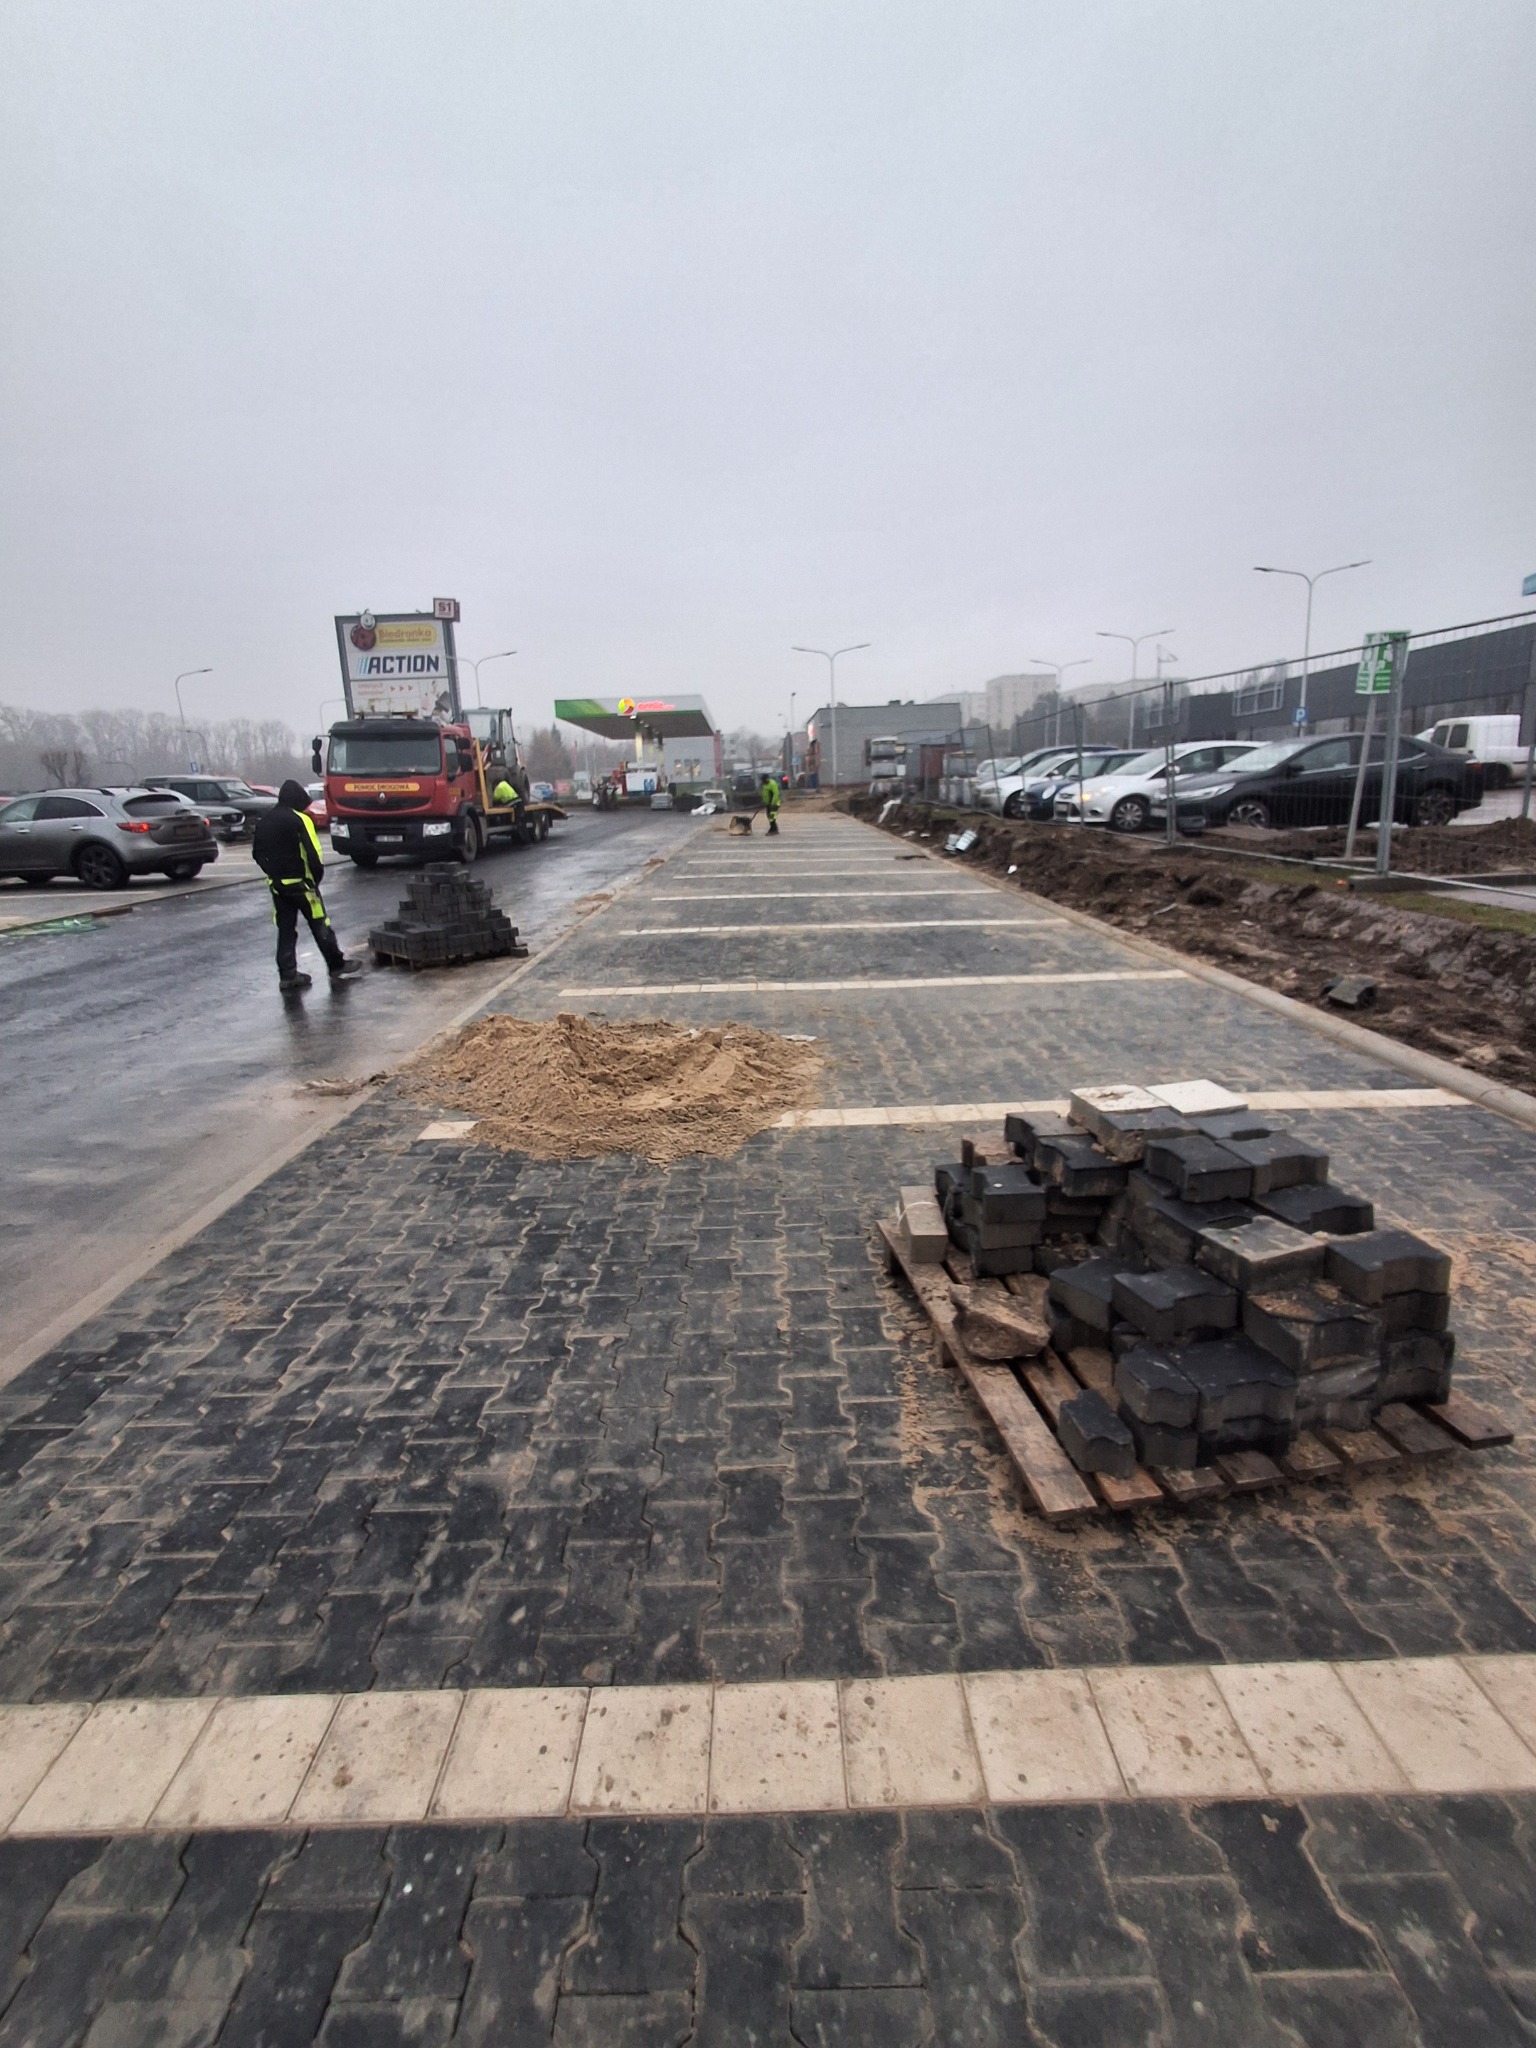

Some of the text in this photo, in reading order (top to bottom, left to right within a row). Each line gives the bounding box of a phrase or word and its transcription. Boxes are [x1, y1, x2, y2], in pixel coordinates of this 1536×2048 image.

[438, 602, 451, 612] S1
[378, 628, 432, 640] Biedronka
[367, 654, 440, 675] ACTION
[1296, 709, 1305, 721] P
